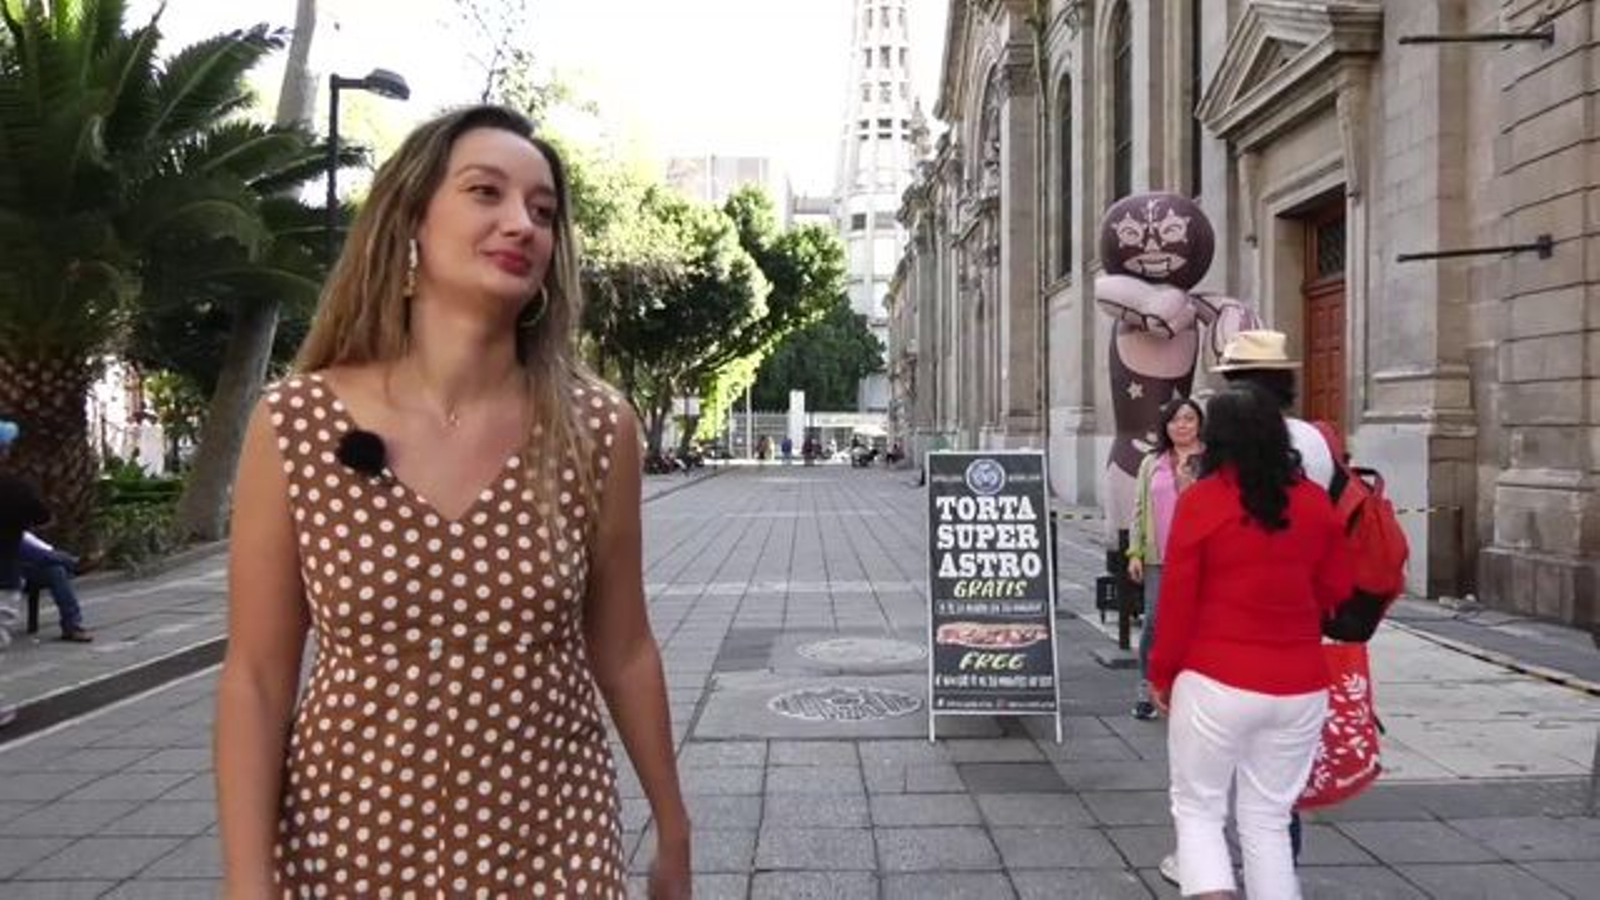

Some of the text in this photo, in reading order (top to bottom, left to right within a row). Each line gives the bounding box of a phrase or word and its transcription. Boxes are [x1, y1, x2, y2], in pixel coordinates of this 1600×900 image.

[936, 496, 1036, 521] TORTA
[937, 524, 1039, 549] SUPER
[938, 552, 1042, 578] ASTRO
[953, 579, 1027, 598] GRATIS
[959, 652, 1027, 670] FREE
